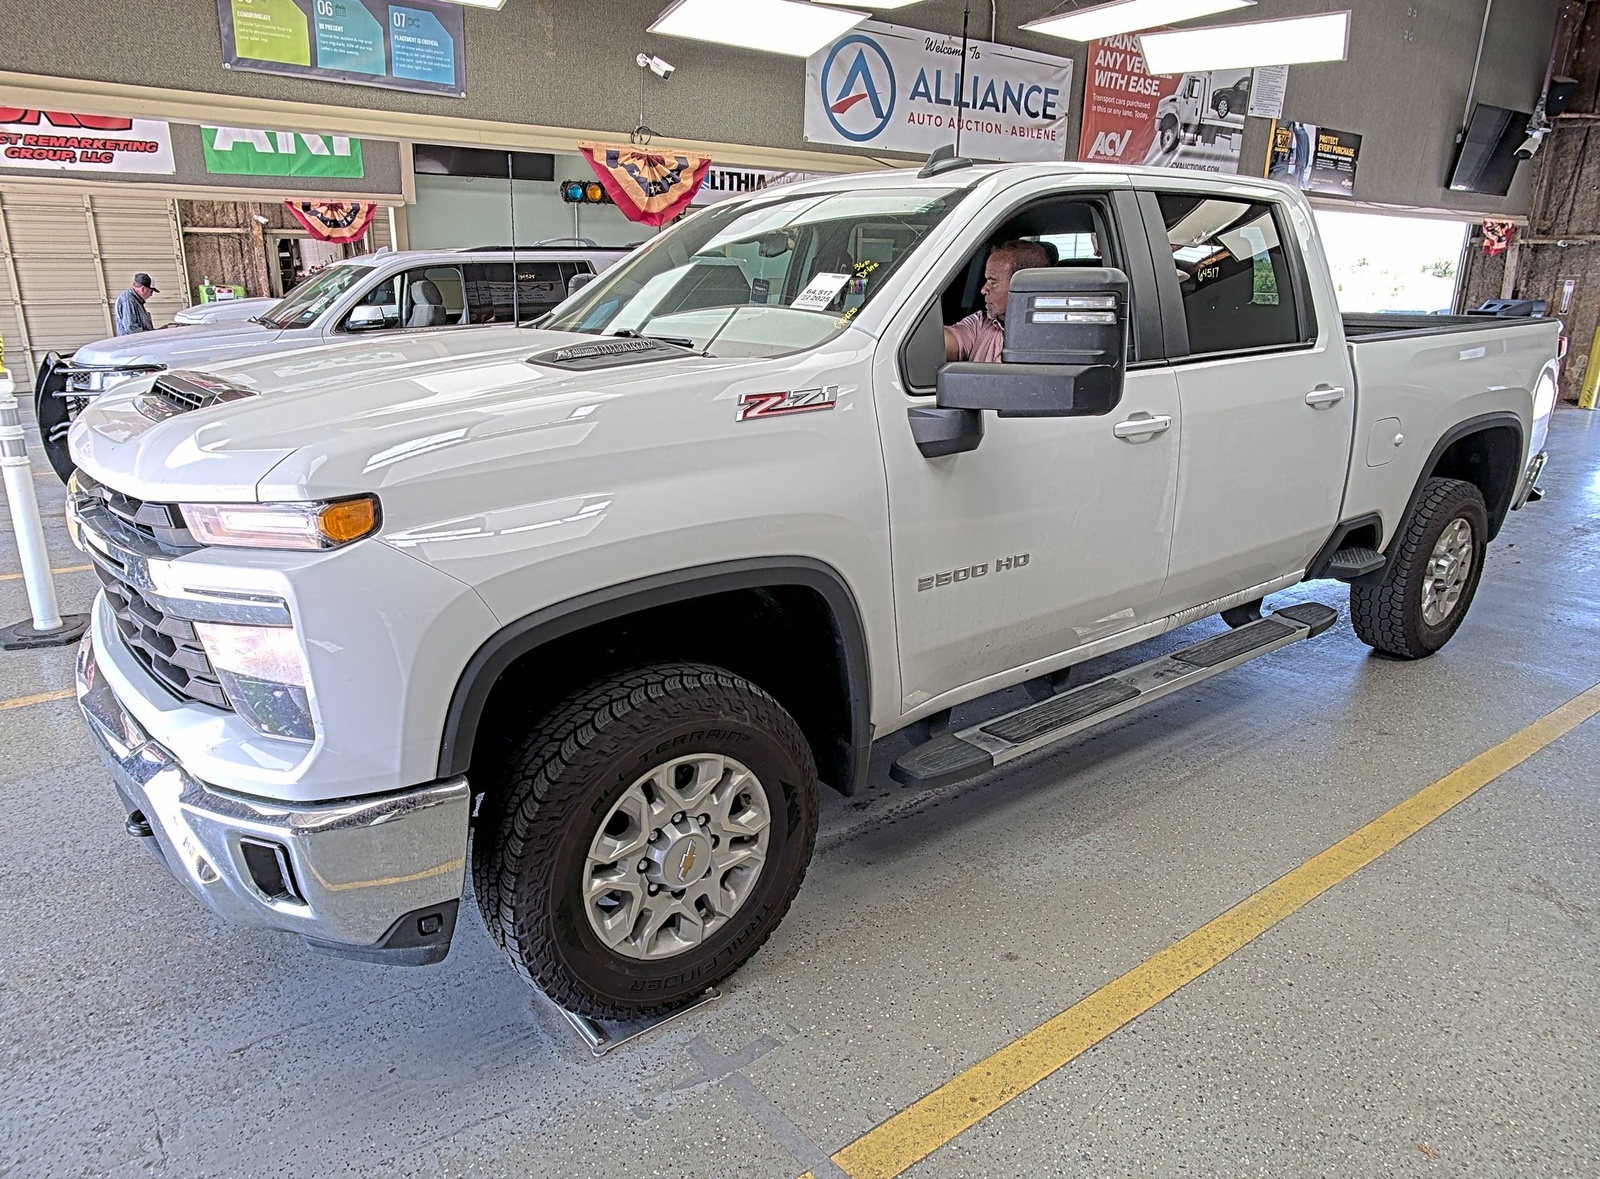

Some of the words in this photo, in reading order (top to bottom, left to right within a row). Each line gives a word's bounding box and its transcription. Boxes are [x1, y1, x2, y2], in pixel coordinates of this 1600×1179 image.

[317, 0, 334, 17] 06
[325, 24, 344, 33] PRESENT
[393, 12, 406, 28] 07
[394, 35, 417, 43] PLACEMENT
[924, 37, 964, 57] Welcome
[970, 46, 981, 60] To
[1094, 49, 1125, 70] ANY
[1094, 69, 1129, 91] WITH
[1128, 75, 1160, 97] EASE.
[909, 67, 1060, 120] ALLIANCE
[1092, 92, 1116, 105] Transport
[1116, 98, 1126, 106] cars
[1126, 99, 1151, 110] purchased
[1092, 103, 1096, 111] in
[1097, 105, 1106, 113] this
[1112, 108, 1121, 116] any
[1122, 109, 1133, 117] lane.
[1134, 110, 1149, 120] Today.
[907, 111, 943, 128] AUTO
[948, 117, 1002, 135] AUCTION
[1010, 122, 1056, 142] ABILENE
[23, 134, 159, 153] REMARKETING
[1087, 129, 1133, 159] ACV
[1318, 144, 1333, 153] EVERY
[1319, 134, 1339, 146] PROTECT
[5, 146, 77, 164] GROUP,
[79, 150, 114, 165] LLC
[710, 170, 768, 193] LITHIA
[1197, 266, 1220, 282] 64517
[736, 384, 839, 422] Z71
[917, 562, 989, 593] 2500
[995, 553, 1030, 573] HD
[590, 771, 633, 816] ALL
[639, 729, 743, 762] TERRAIN
